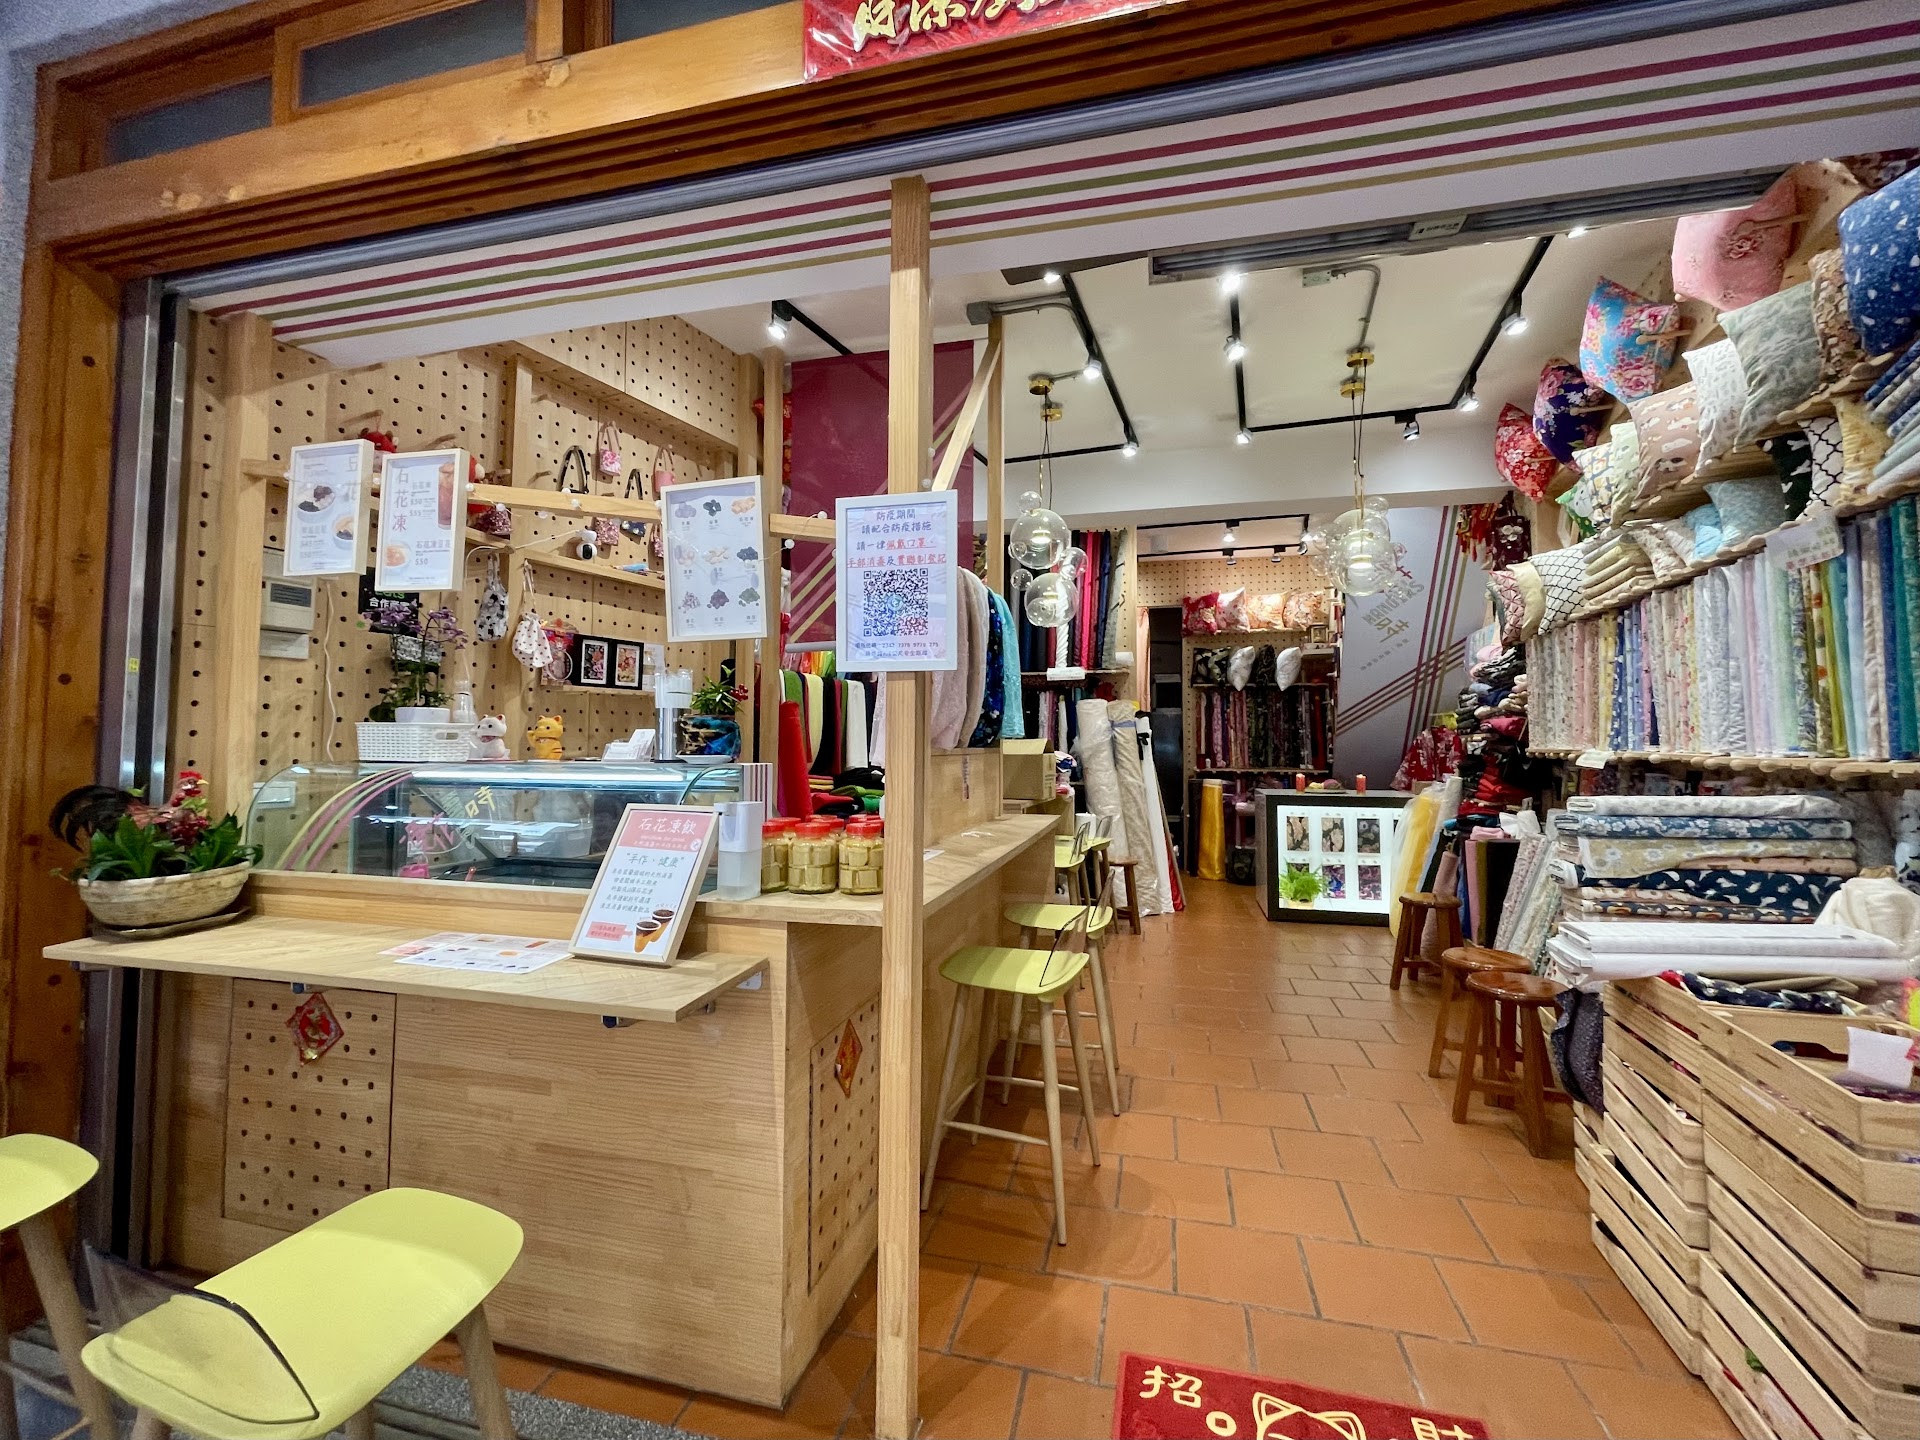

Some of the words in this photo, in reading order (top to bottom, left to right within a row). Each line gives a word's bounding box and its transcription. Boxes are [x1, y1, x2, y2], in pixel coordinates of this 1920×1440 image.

[876, 509, 916, 521] 防疫期間
[861, 522, 932, 534] 請配合防疫措施
[638, 817, 697, 836] 石花凍飲
[1139, 1365, 1202, 1409] 招
